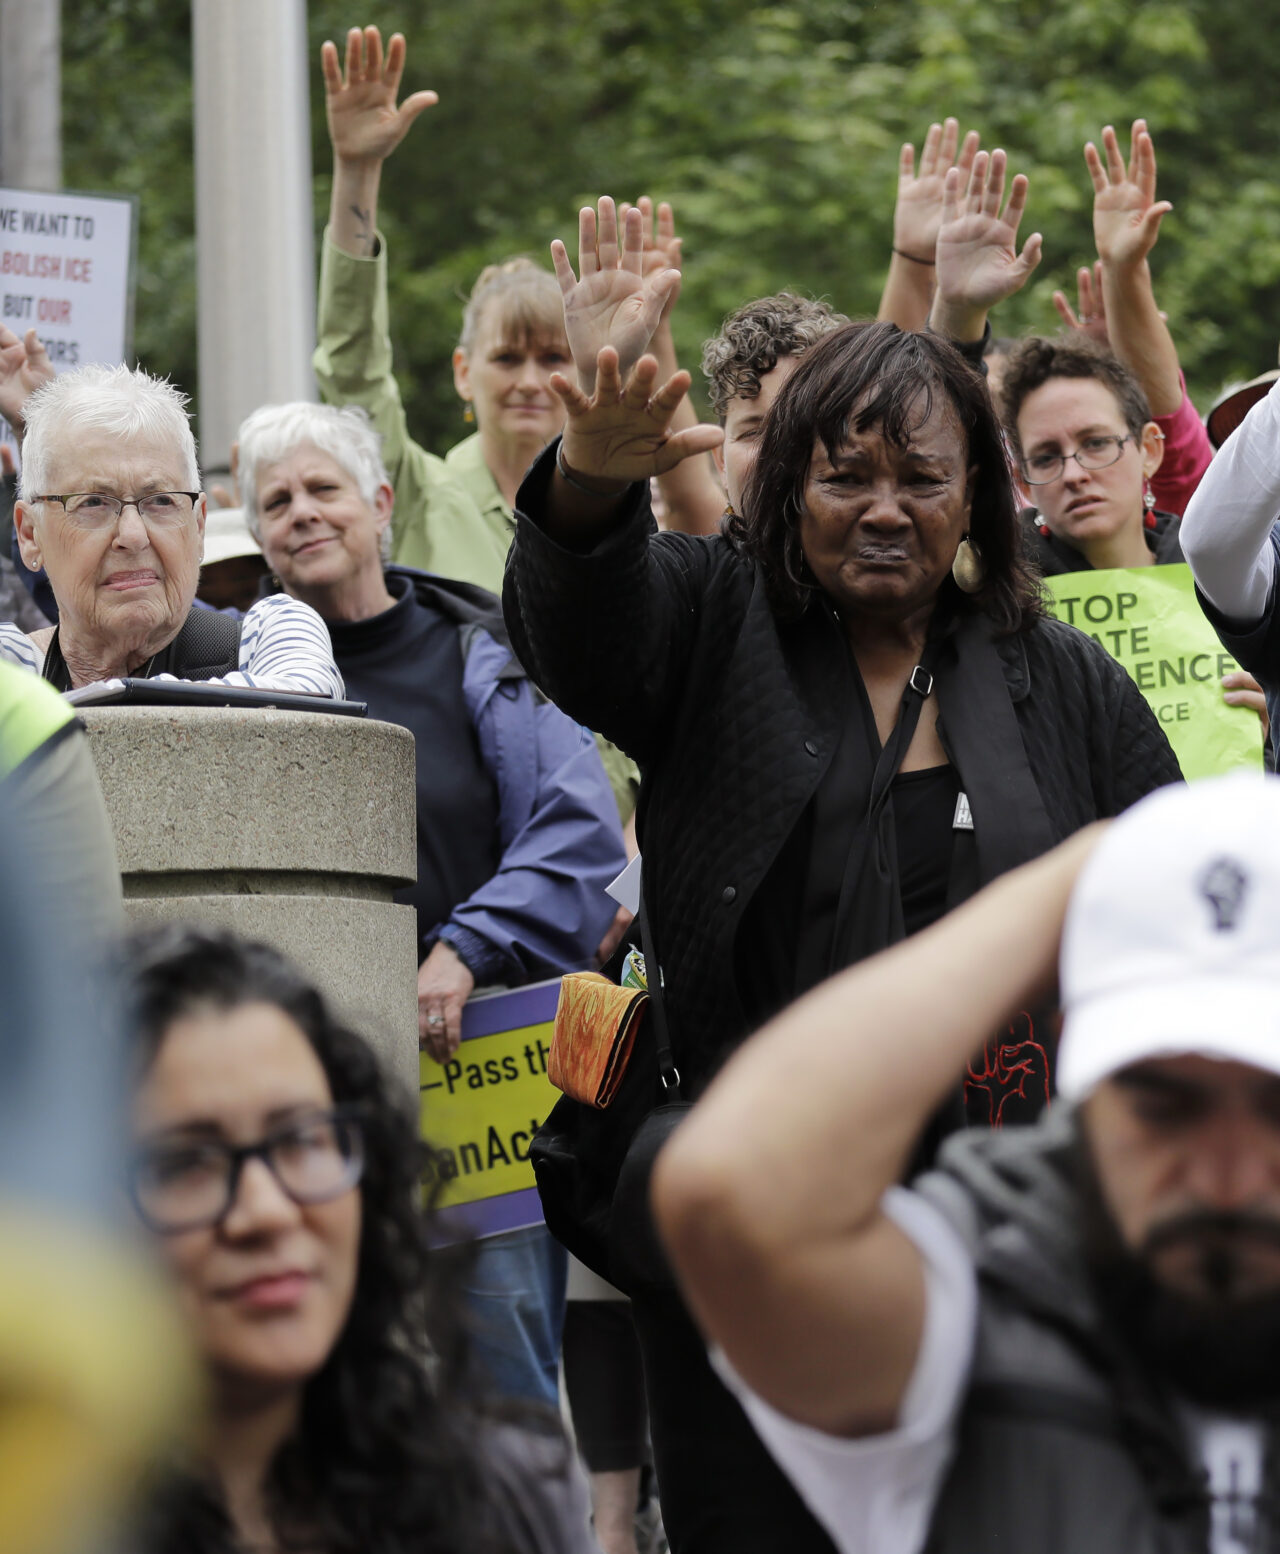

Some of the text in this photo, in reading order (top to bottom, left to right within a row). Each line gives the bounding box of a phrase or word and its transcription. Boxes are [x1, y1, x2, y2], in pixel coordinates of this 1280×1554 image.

[22, 211, 68, 238] WANT
[74, 215, 94, 240] TO
[0, 251, 92, 283] BOLISH ICE
[3, 294, 72, 325] BUT OUR
[1135, 653, 1236, 690] ENCE
